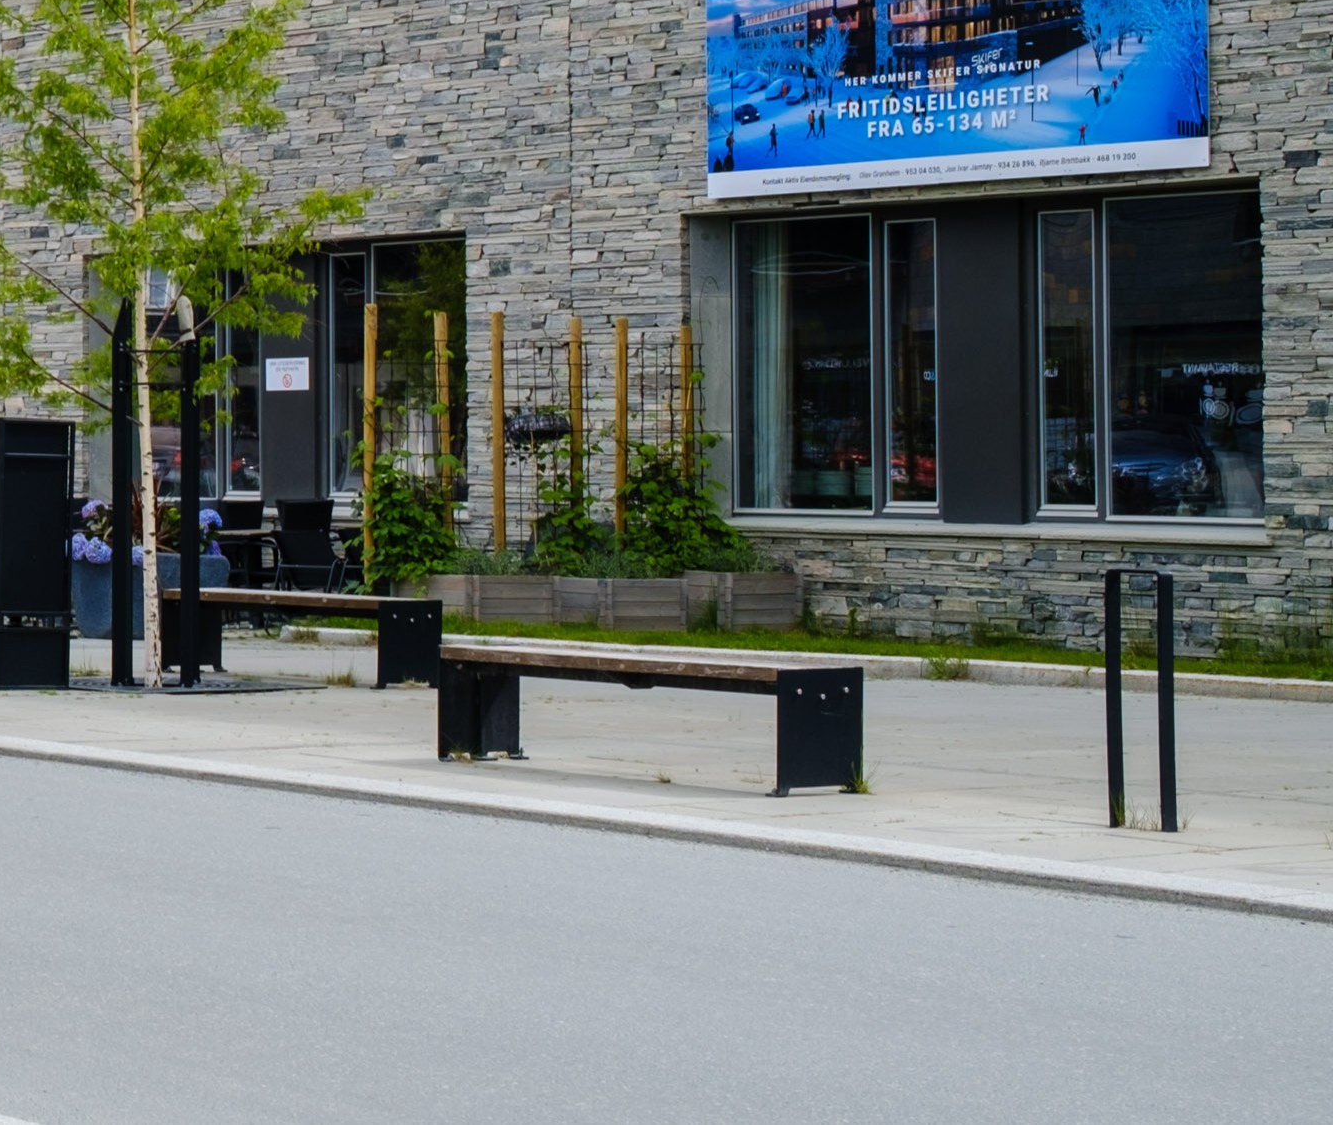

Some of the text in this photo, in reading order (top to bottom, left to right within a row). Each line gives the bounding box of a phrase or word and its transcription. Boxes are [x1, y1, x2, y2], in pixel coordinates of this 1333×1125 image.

[844, 59, 1042, 87] HER KOMMER SKIFER SIGNATUR
[837, 84, 1049, 120] FRITIDSLEILIGHETER
[867, 119, 904, 139] FRA
[911, 113, 983, 135] 65-134
[785, 176, 799, 184] Aktiv
[905, 167, 917, 175] 953
[919, 166, 927, 174] 04
[1096, 154, 1110, 162] 468
[1113, 153, 1121, 161] 19
[1122, 152, 1136, 160] 200
